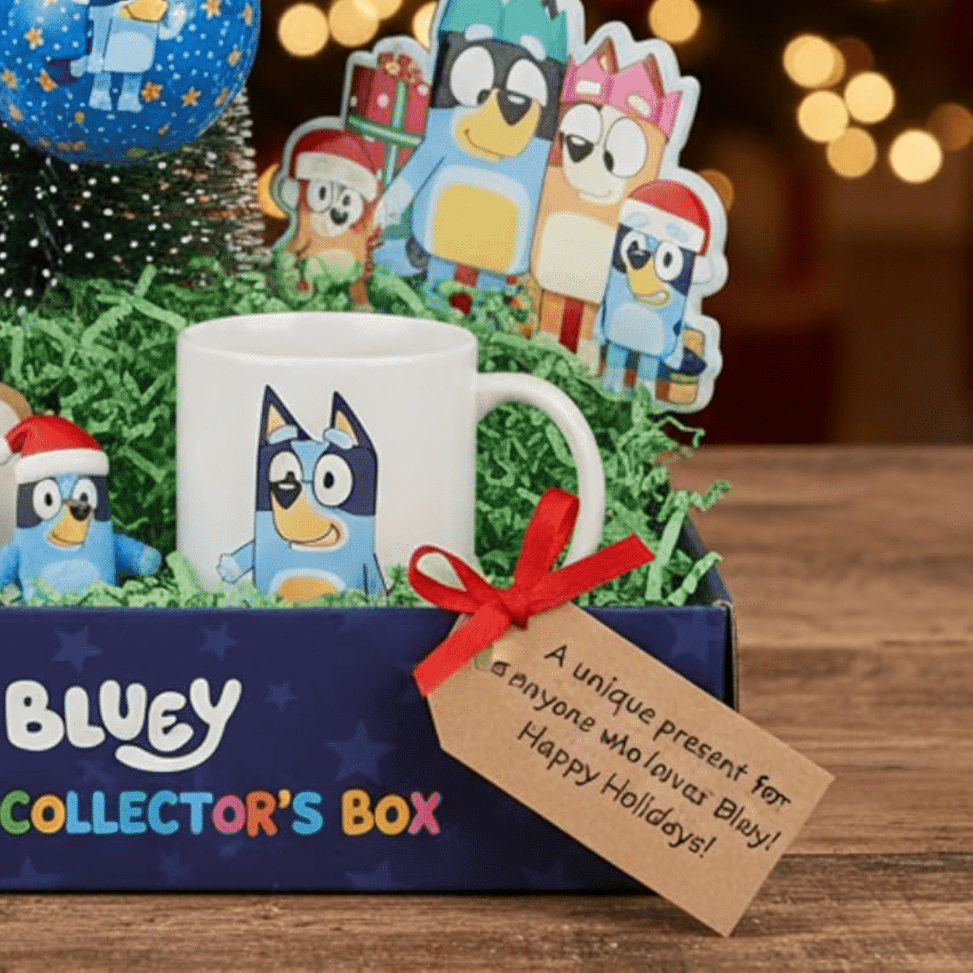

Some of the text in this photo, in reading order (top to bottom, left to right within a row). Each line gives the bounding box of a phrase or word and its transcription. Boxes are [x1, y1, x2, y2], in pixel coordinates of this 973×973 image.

[5, 678, 242, 773] BLUEY
[543, 644, 568, 668] A
[572, 662, 656, 725] unique
[653, 719, 749, 782] present
[341, 789, 441, 836] BOX
[517, 720, 717, 859] Happy Holidays!
